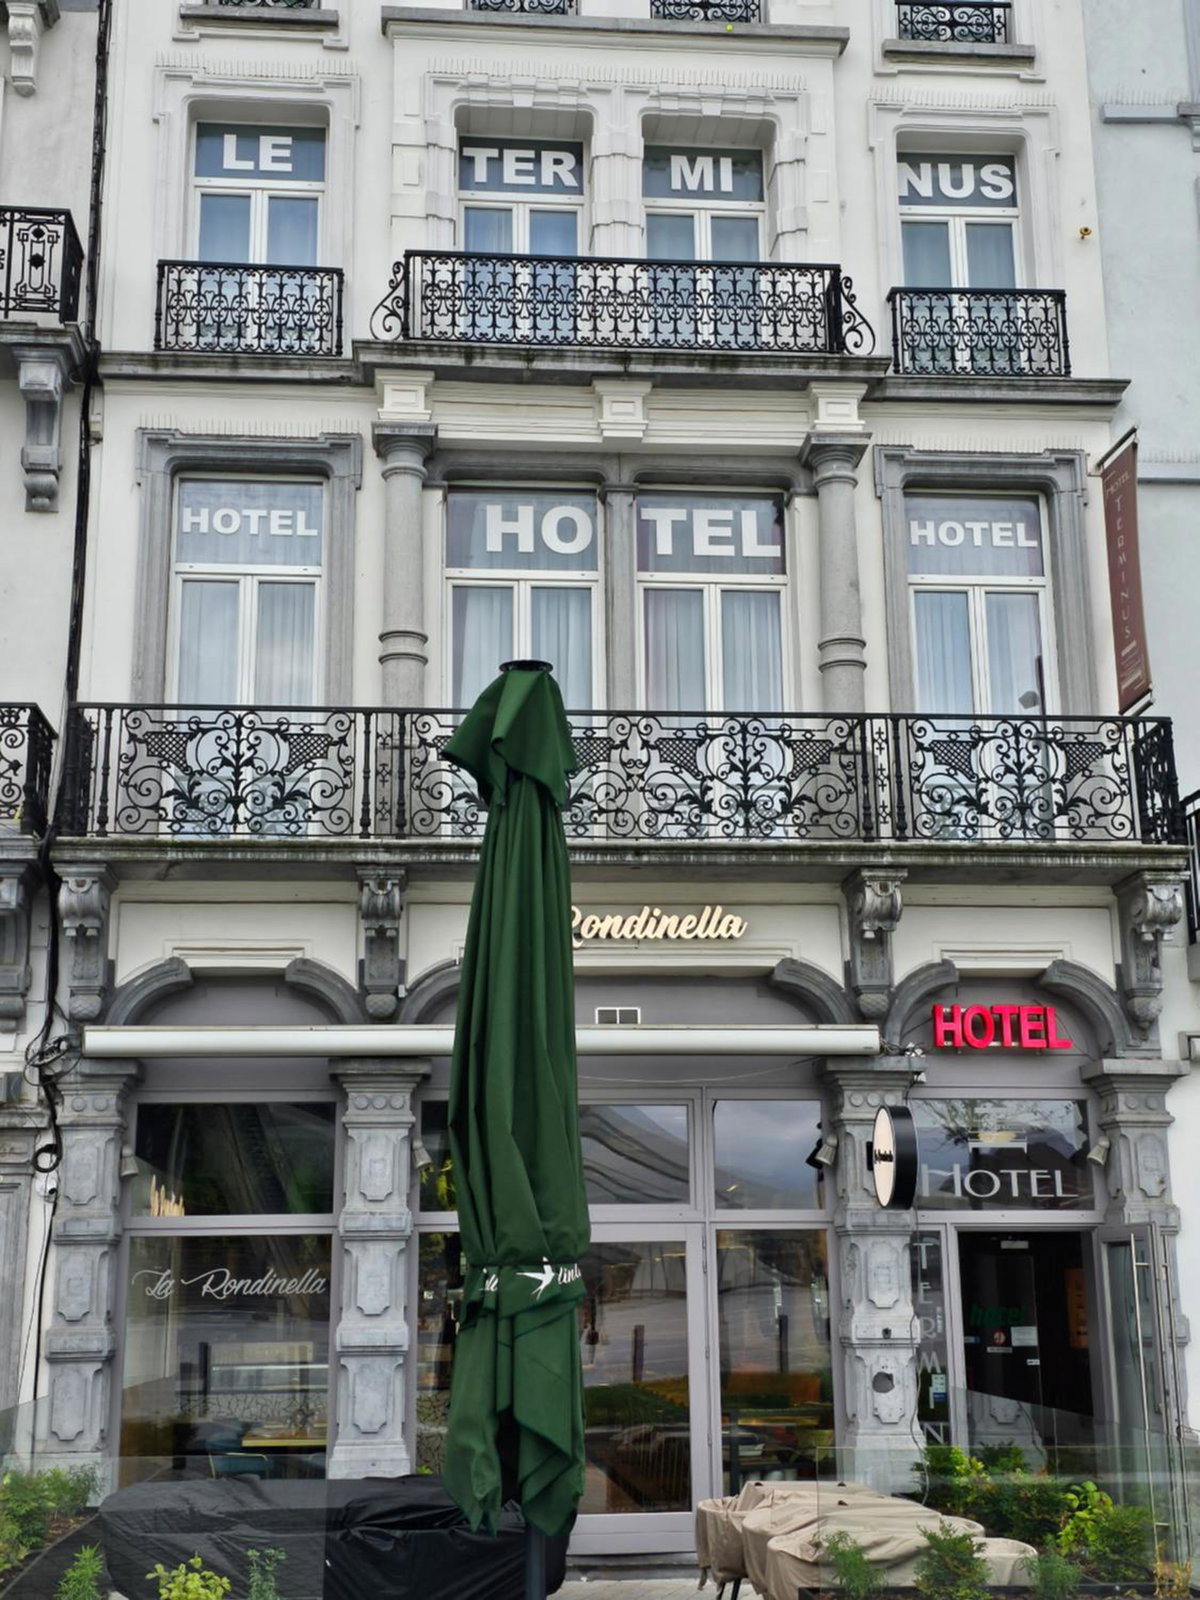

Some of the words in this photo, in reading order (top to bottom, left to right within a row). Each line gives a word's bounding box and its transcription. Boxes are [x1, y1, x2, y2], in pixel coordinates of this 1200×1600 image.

[223, 134, 293, 172] LE
[462, 147, 577, 187] TER
[670, 155, 733, 192] MI
[897, 163, 1014, 199] NUS
[181, 508, 319, 537] HOTEL
[486, 505, 593, 554] HO
[640, 508, 781, 557] TEL
[909, 520, 1038, 549] HOTEL
[932, 1004, 1073, 1050] HOTEL
[921, 1163, 1078, 1198] HOTEL
[131, 1268, 174, 1300] La
[180, 1267, 327, 1300] Rondinella
